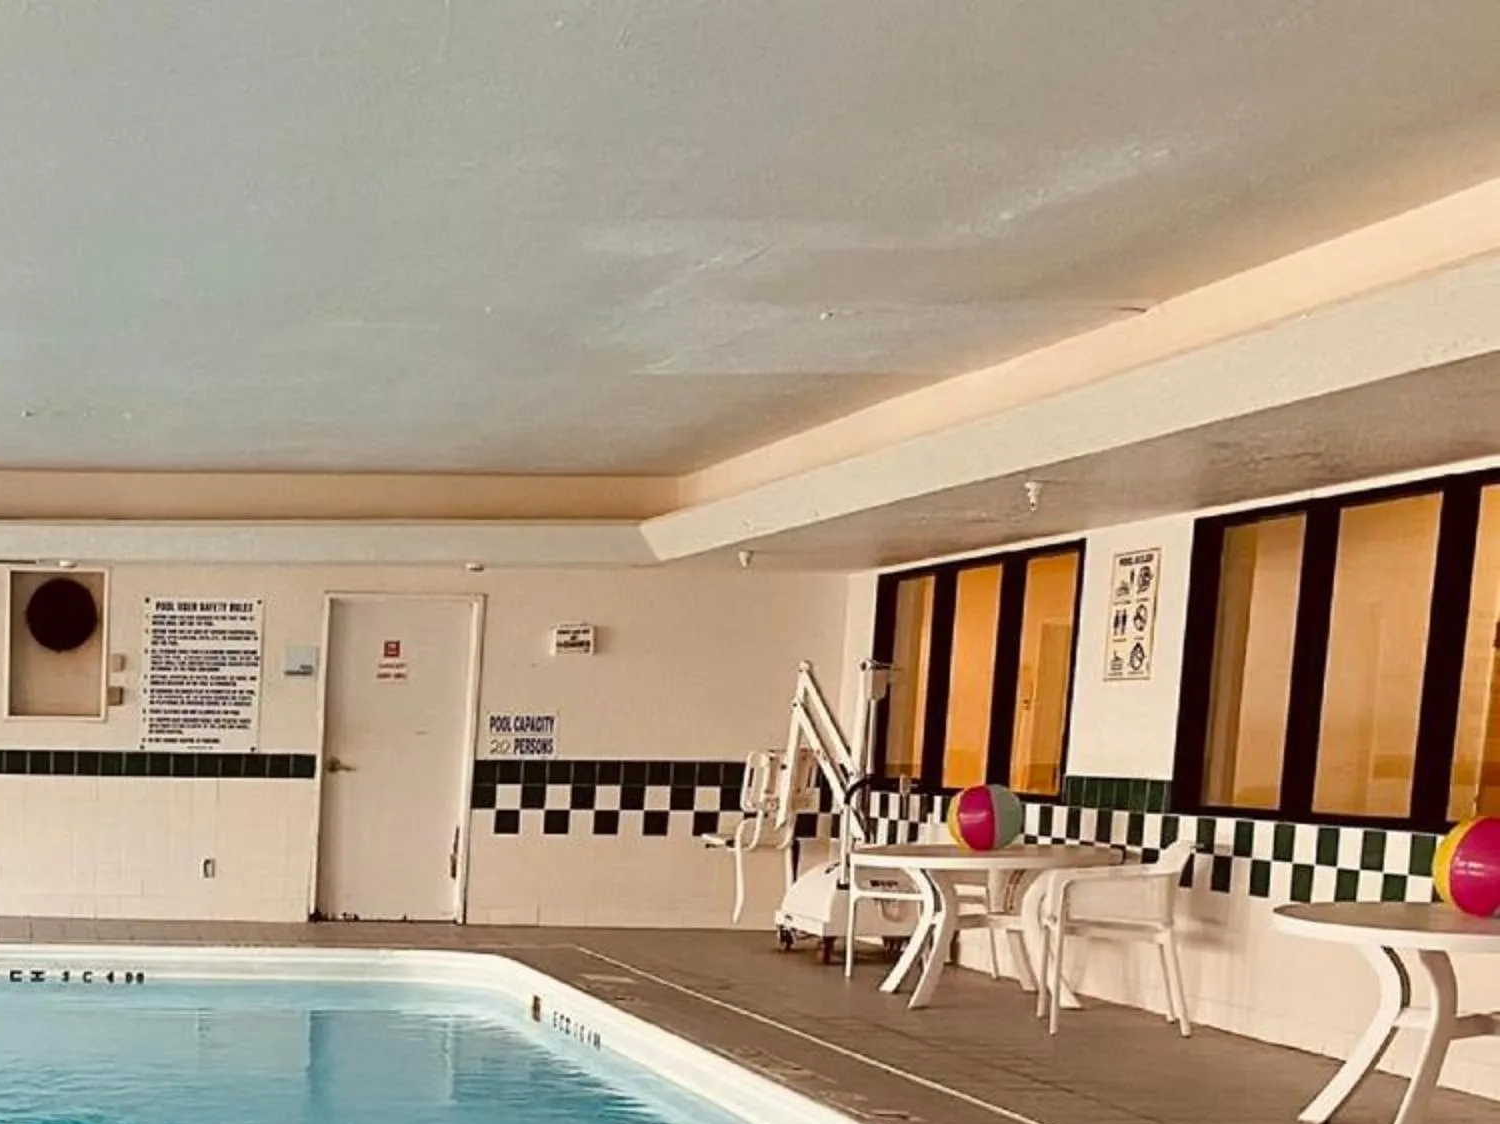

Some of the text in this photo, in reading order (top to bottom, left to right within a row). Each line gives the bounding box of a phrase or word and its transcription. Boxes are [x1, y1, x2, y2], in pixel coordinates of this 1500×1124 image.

[155, 602, 175, 611] POOL
[200, 602, 227, 612] SAFETY
[229, 603, 254, 613] RULES
[489, 715, 556, 733] POOL CAPACITY
[513, 738, 554, 755] PERSONS
